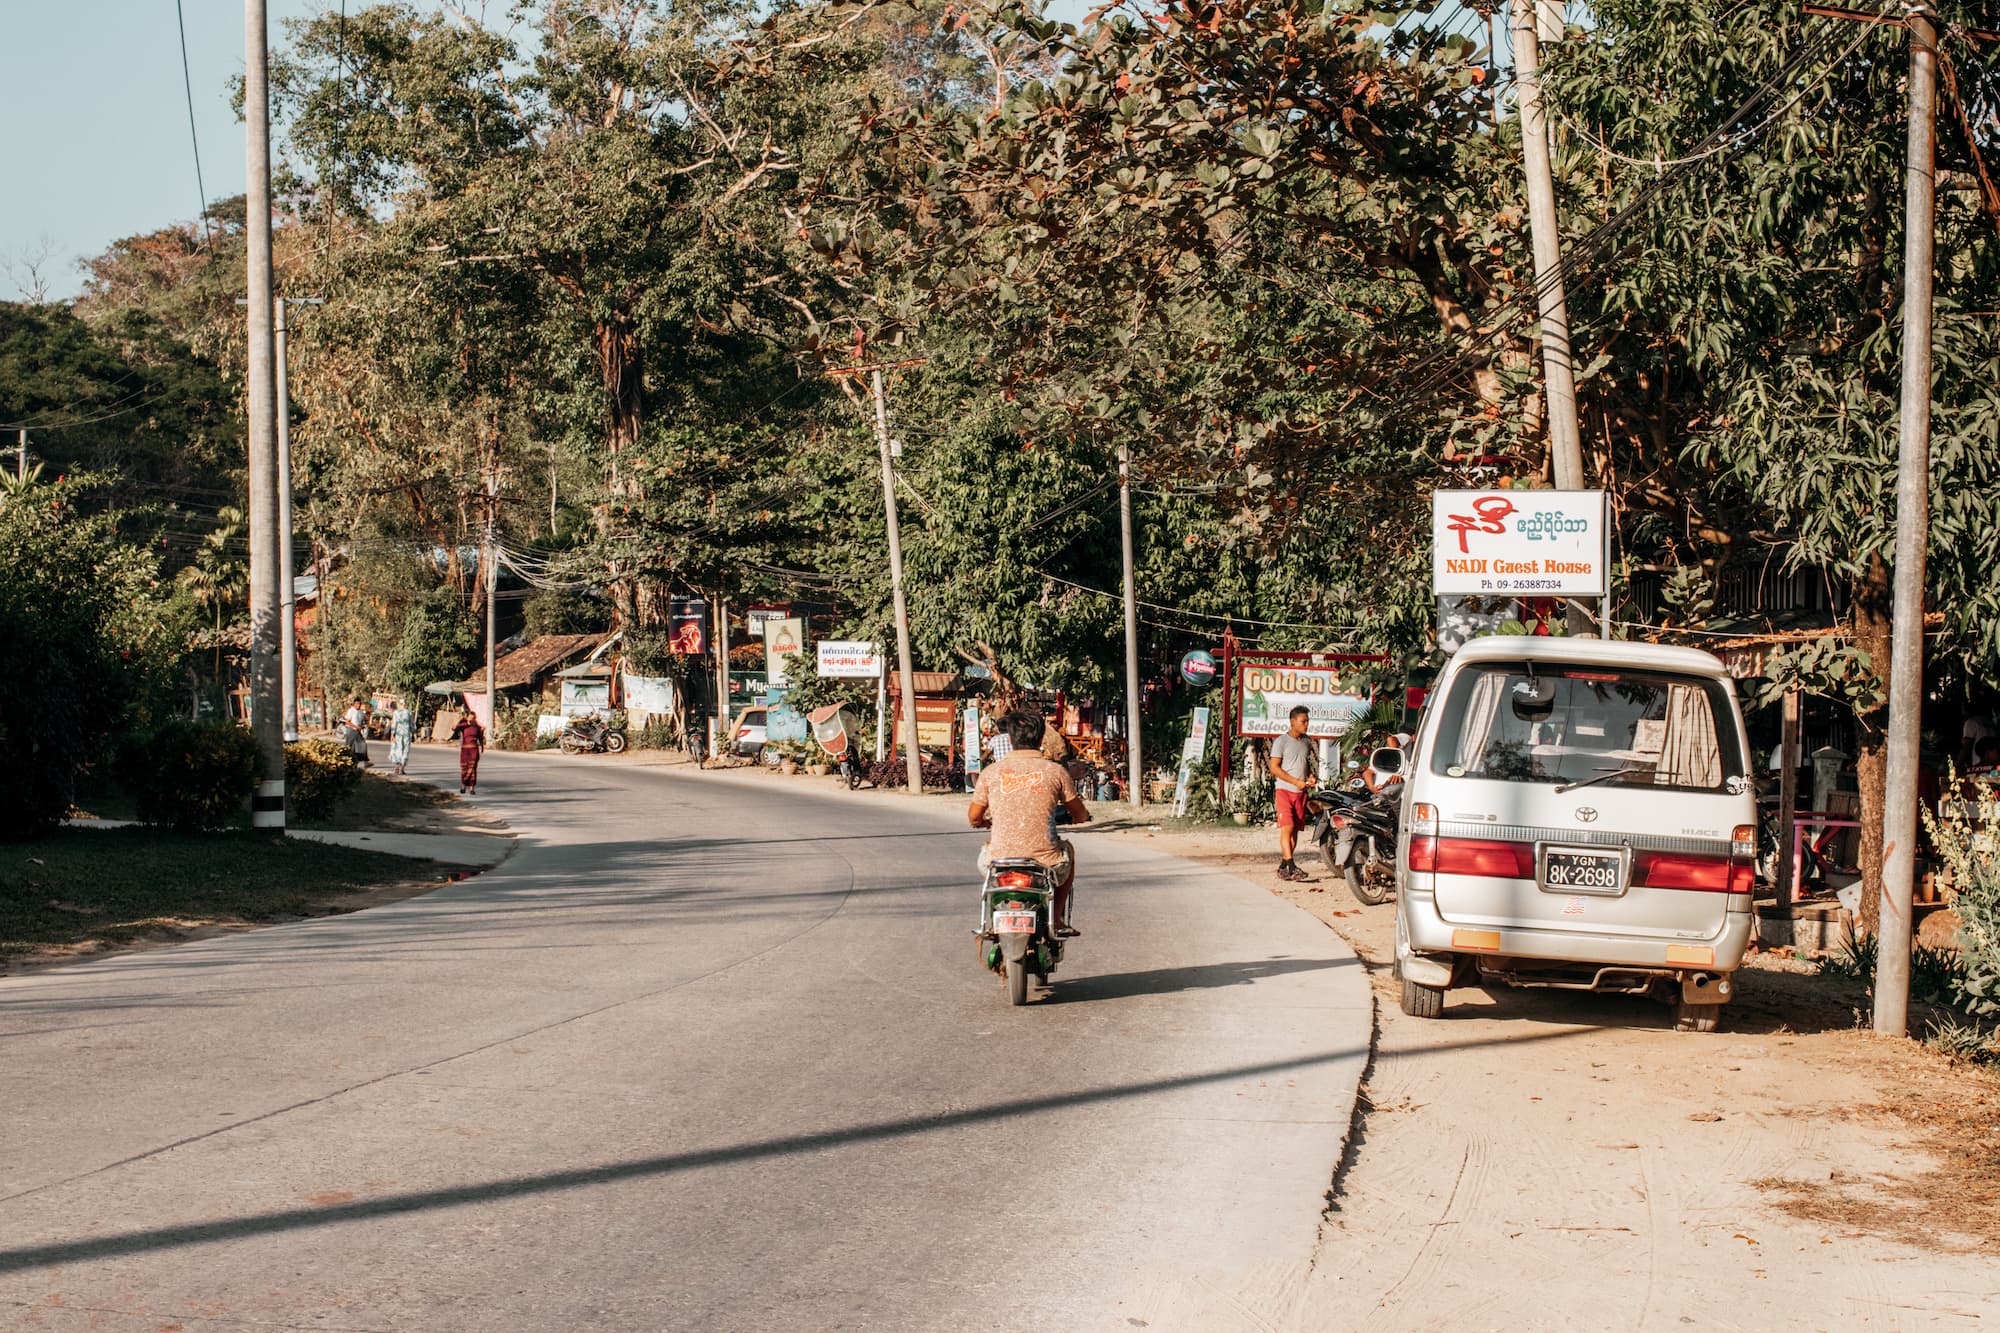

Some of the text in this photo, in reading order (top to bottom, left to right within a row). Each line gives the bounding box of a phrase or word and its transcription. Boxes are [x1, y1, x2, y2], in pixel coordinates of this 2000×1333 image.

[1446, 559, 1592, 575] NADI Guest House
[1481, 580, 1492, 589] Ph
[1245, 670, 1324, 695] Golden
[1247, 720, 1289, 734] Seafoo
[1571, 855, 1597, 867] YGN
[1550, 865, 1616, 886] 8K-2698
